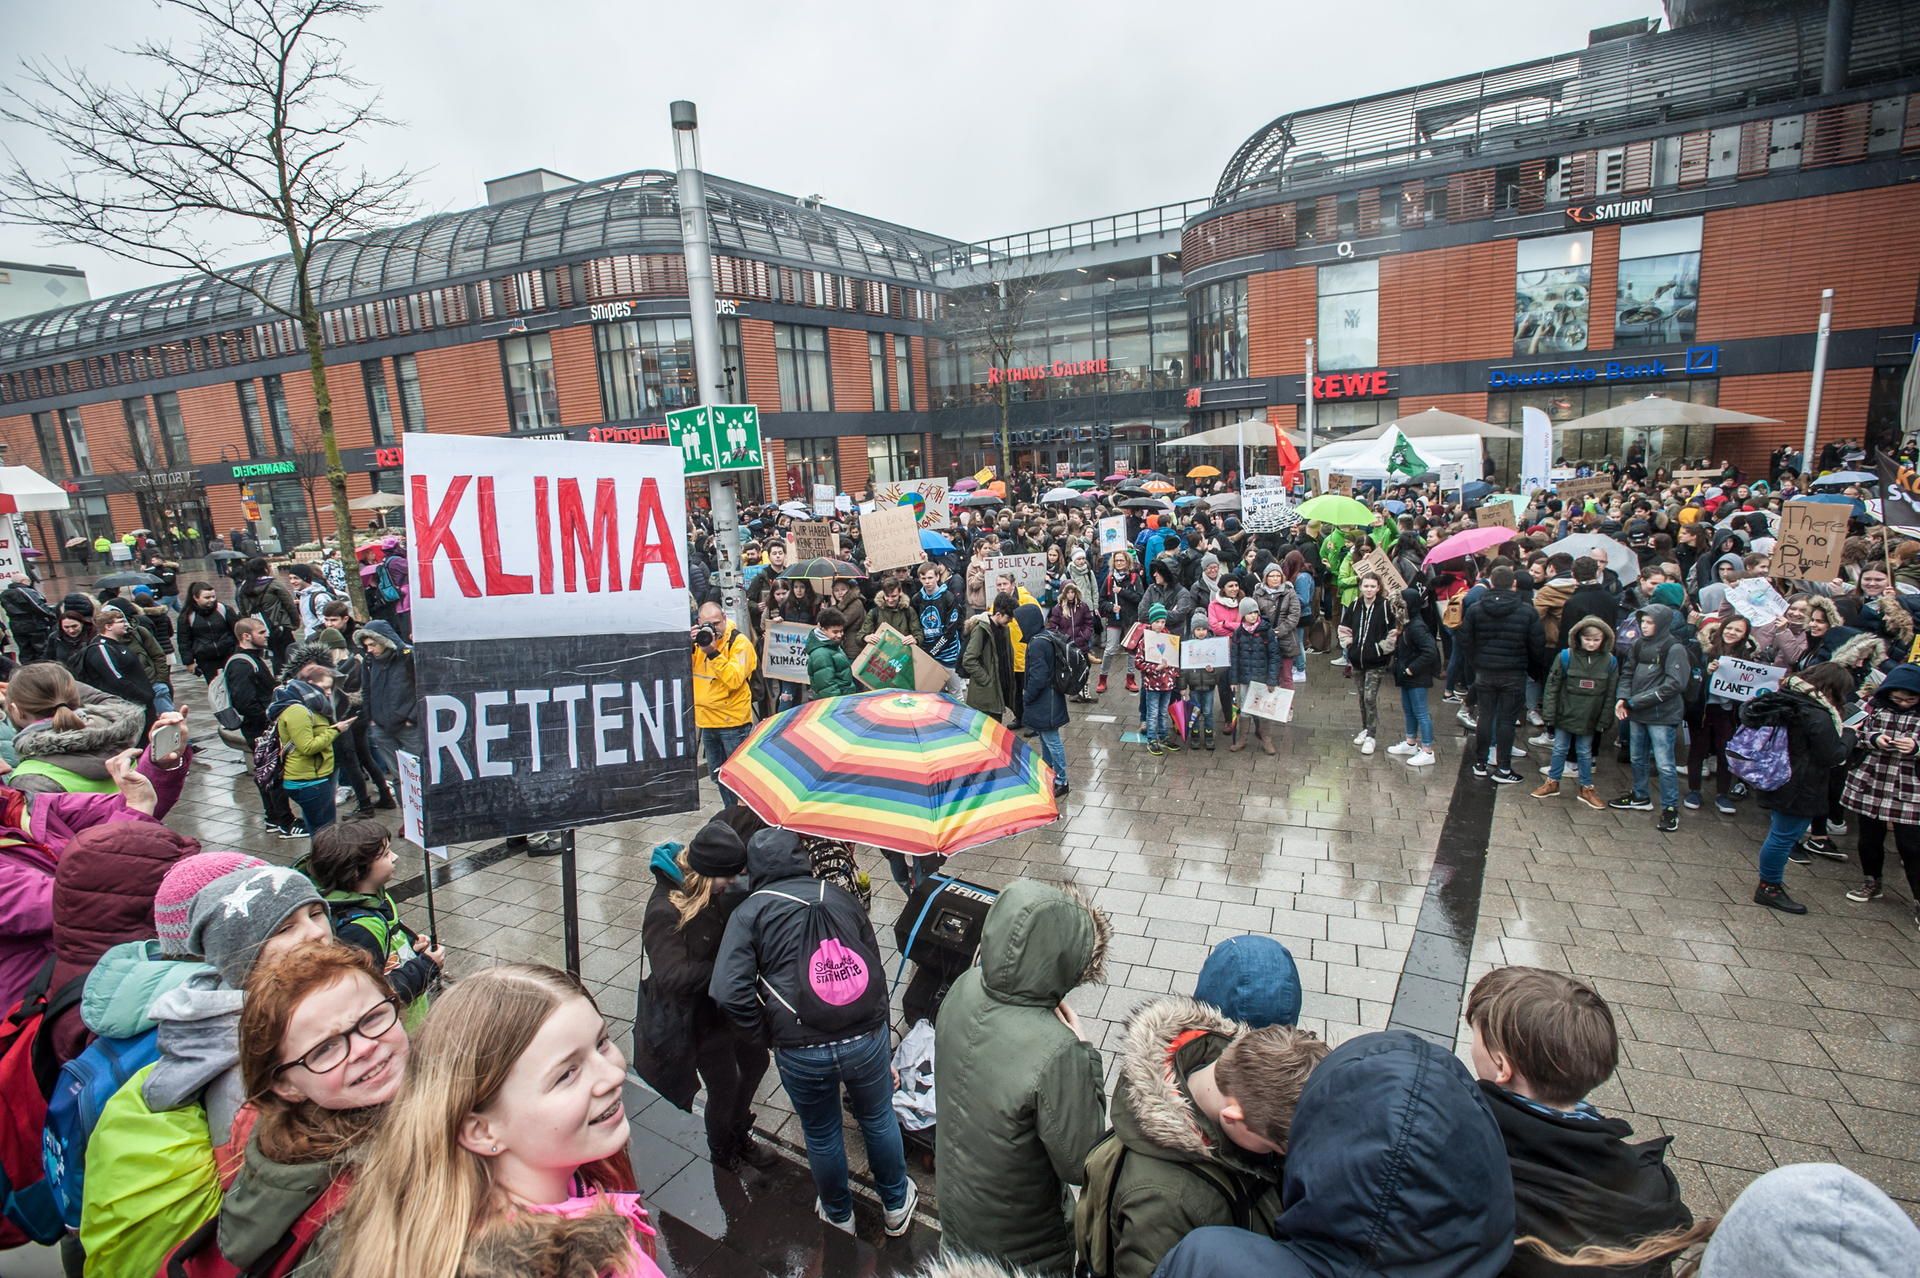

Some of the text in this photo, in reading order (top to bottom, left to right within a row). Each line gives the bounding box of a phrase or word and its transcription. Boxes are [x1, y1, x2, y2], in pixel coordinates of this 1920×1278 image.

[1595, 198, 1653, 220] SATURN
[591, 301, 631, 322] snipes
[1490, 359, 1667, 387] Deutsche Bank
[1312, 371, 1389, 399] REWE
[602, 424, 669, 444] Pinguin
[992, 424, 1112, 445] KINOPOLIS
[232, 461, 296, 478] DEICHMANN
[875, 483, 905, 512] MAKE
[917, 482, 946, 505] EARTH
[1784, 505, 1845, 534] There
[410, 475, 685, 599] KLIMA
[794, 525, 830, 537] WIR HABEN
[1782, 530, 1827, 547] is no
[813, 538, 826, 549] ZEIT
[985, 556, 1037, 570] I BELIEVE
[1779, 544, 1831, 569] Planet
[1731, 659, 1769, 676] There's
[1739, 673, 1755, 683] NO
[1714, 679, 1754, 696] PLANET
[425, 679, 685, 784] RETTEN!
[945, 883, 997, 905] FAME
